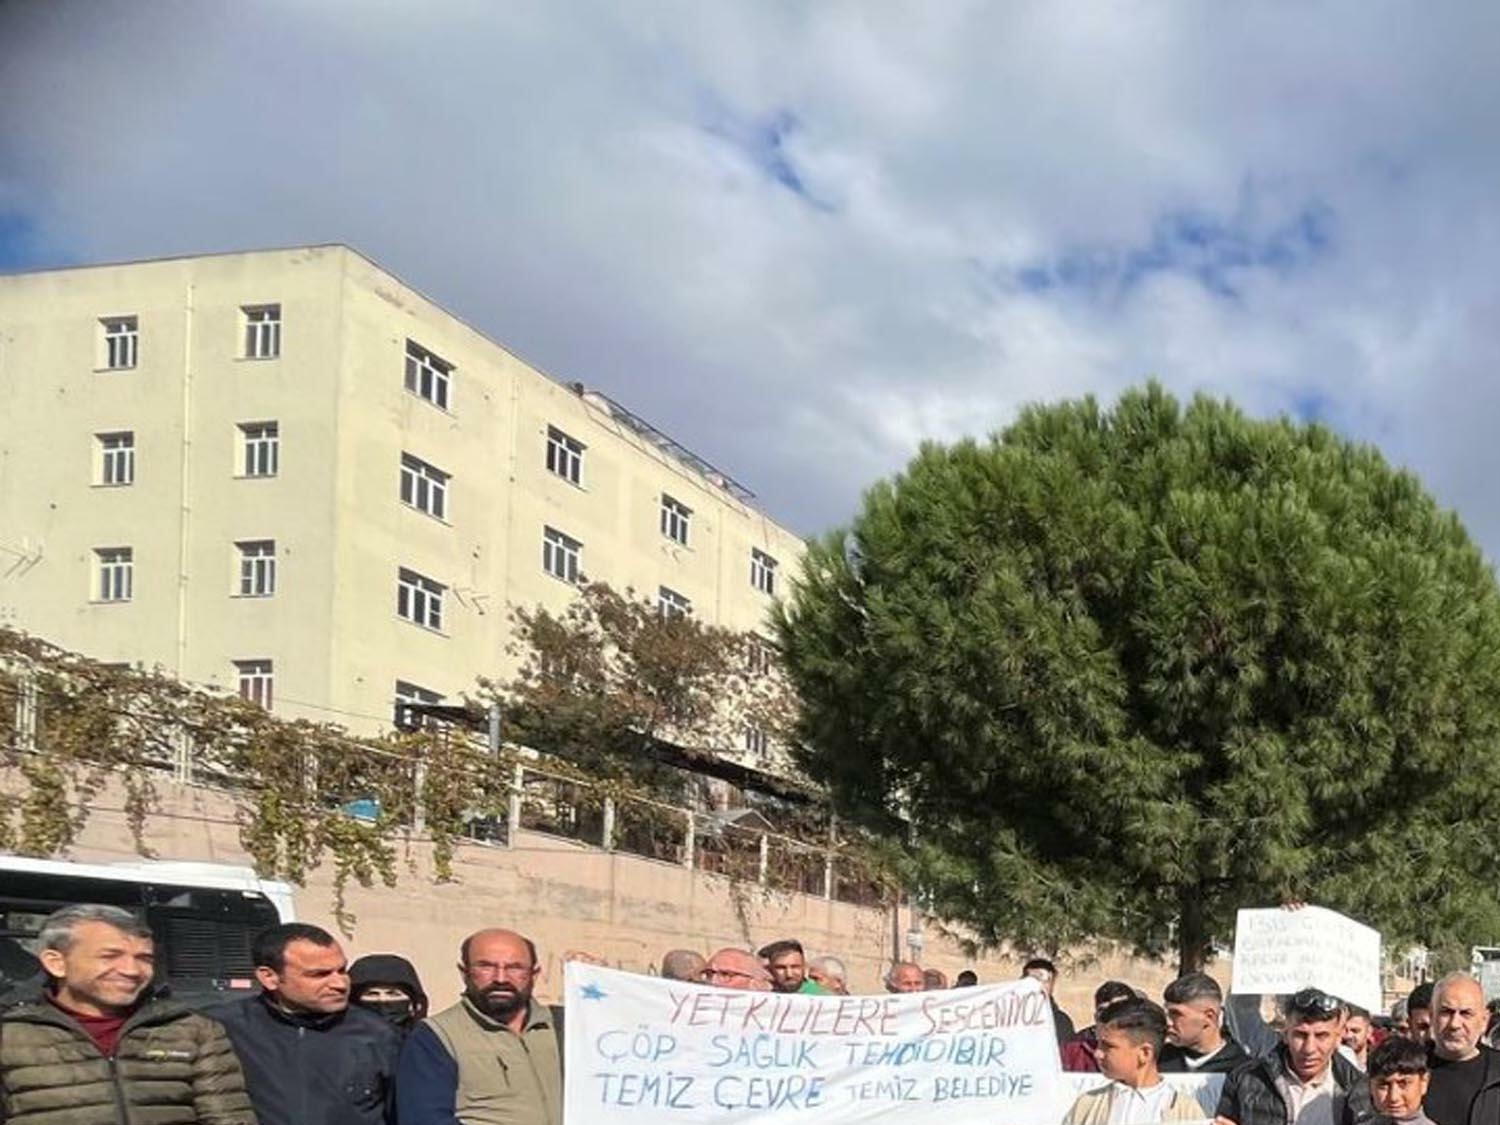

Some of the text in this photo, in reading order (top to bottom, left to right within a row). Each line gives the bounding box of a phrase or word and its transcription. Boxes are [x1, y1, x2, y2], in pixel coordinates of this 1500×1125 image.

[597, 1023, 677, 1063] ÇÖP
[707, 1033, 818, 1068] SAĞLIK
[594, 1070, 694, 1109] TEMİZ
[714, 1075, 827, 1111] ÇEVRE
[849, 1078, 921, 1103] TEMİZ
[933, 1072, 1033, 1103] BELEDİYE
